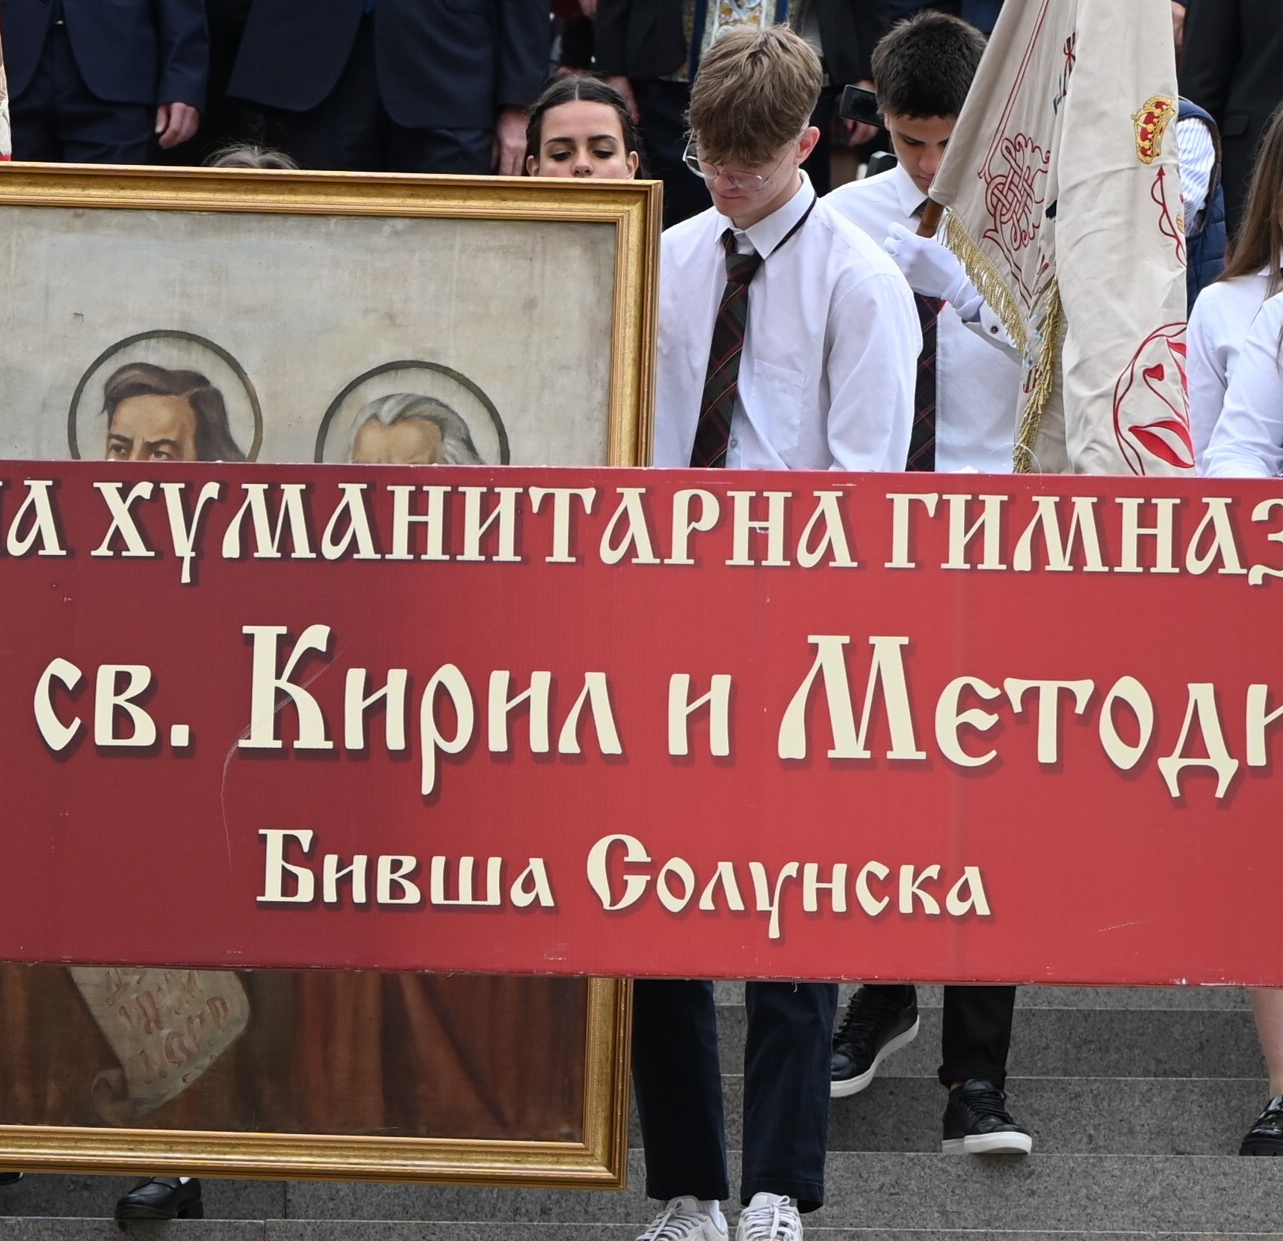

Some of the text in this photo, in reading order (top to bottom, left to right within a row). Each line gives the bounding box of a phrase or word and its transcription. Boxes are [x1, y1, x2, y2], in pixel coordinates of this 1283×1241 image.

[90, 481, 858, 584] ХУМАНИТАРНА
[33, 657, 190, 751] св.
[237, 624, 623, 796] Кирил
[668, 673, 732, 757] и
[256, 828, 991, 939] Бивша Солунска
